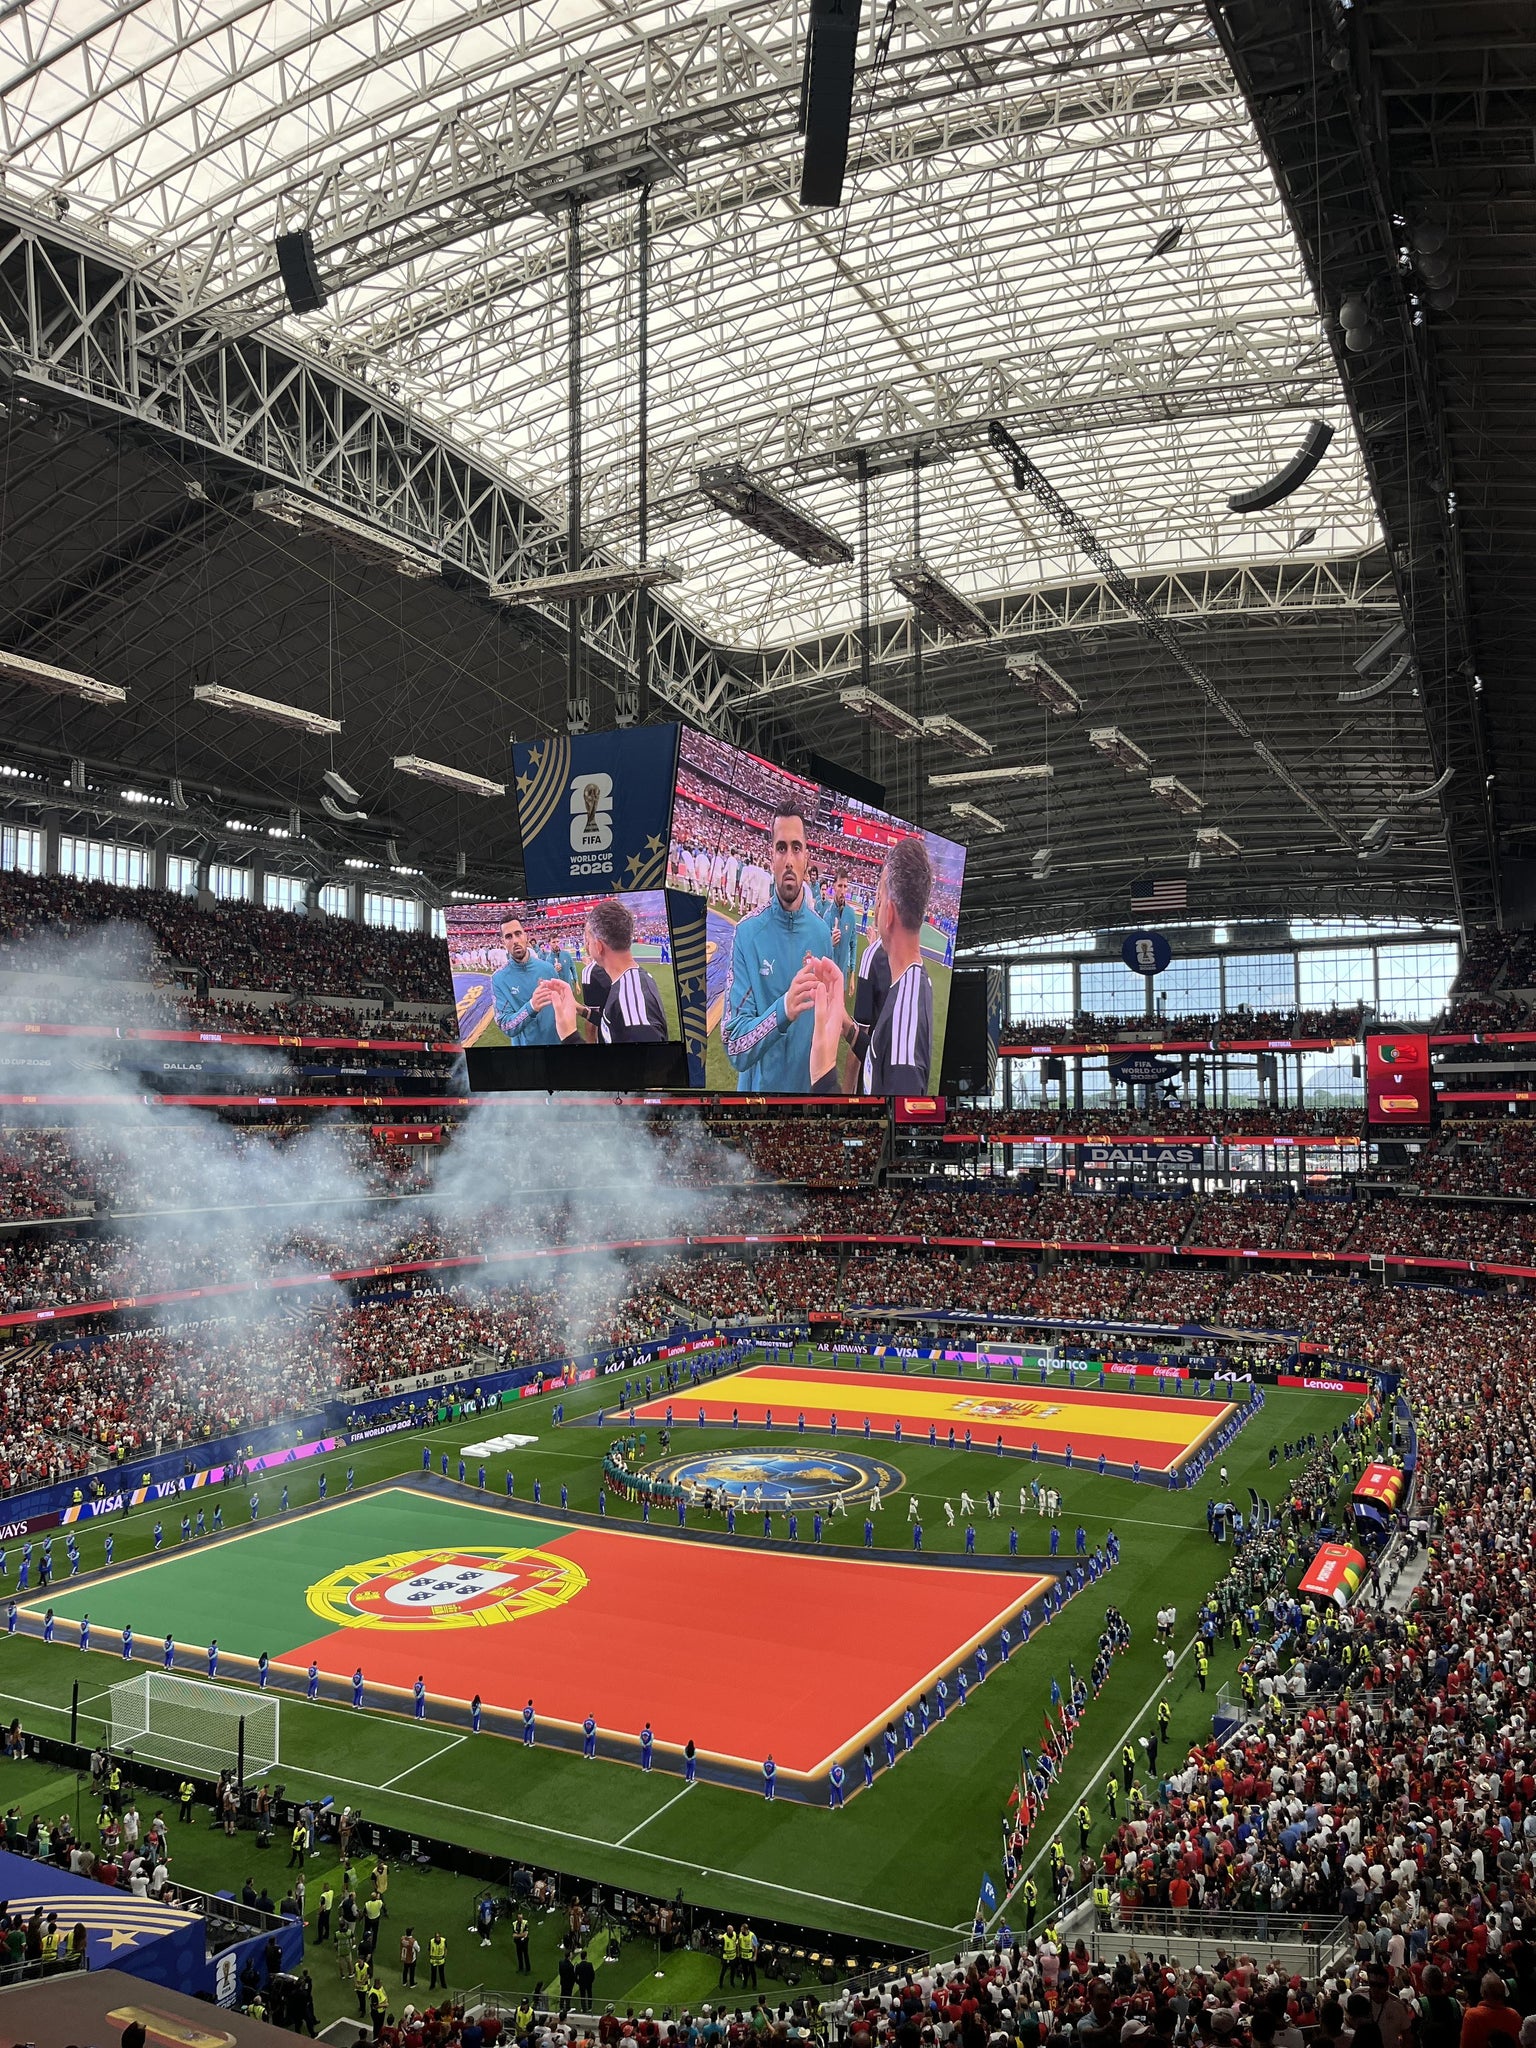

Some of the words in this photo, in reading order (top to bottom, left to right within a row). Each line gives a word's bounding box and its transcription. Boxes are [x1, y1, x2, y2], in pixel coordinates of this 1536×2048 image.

[582, 836, 601, 845] FIFA
[570, 854, 597, 863] WORLD
[598, 853, 613, 861] CUP
[570, 862, 613, 875] 2026
[1091, 1150, 1194, 1162] DALLAS
[992, 1314, 1062, 1322] WORLD
[1105, 1321, 1180, 1330] 2026
[692, 1340, 714, 1350] Lenovo
[832, 1344, 867, 1354] AIRWAYS
[667, 1346, 686, 1357] Lenovo
[896, 1348, 919, 1358] VISA
[1037, 1357, 1088, 1371] aramco
[1303, 1378, 1344, 1391] Lenovo
[351, 1432, 364, 1442] FIFA
[364, 1426, 385, 1439] WORLD
[385, 1422, 397, 1433] CUP
[157, 1478, 186, 1498] VISA
[91, 1493, 123, 1516] VISA
